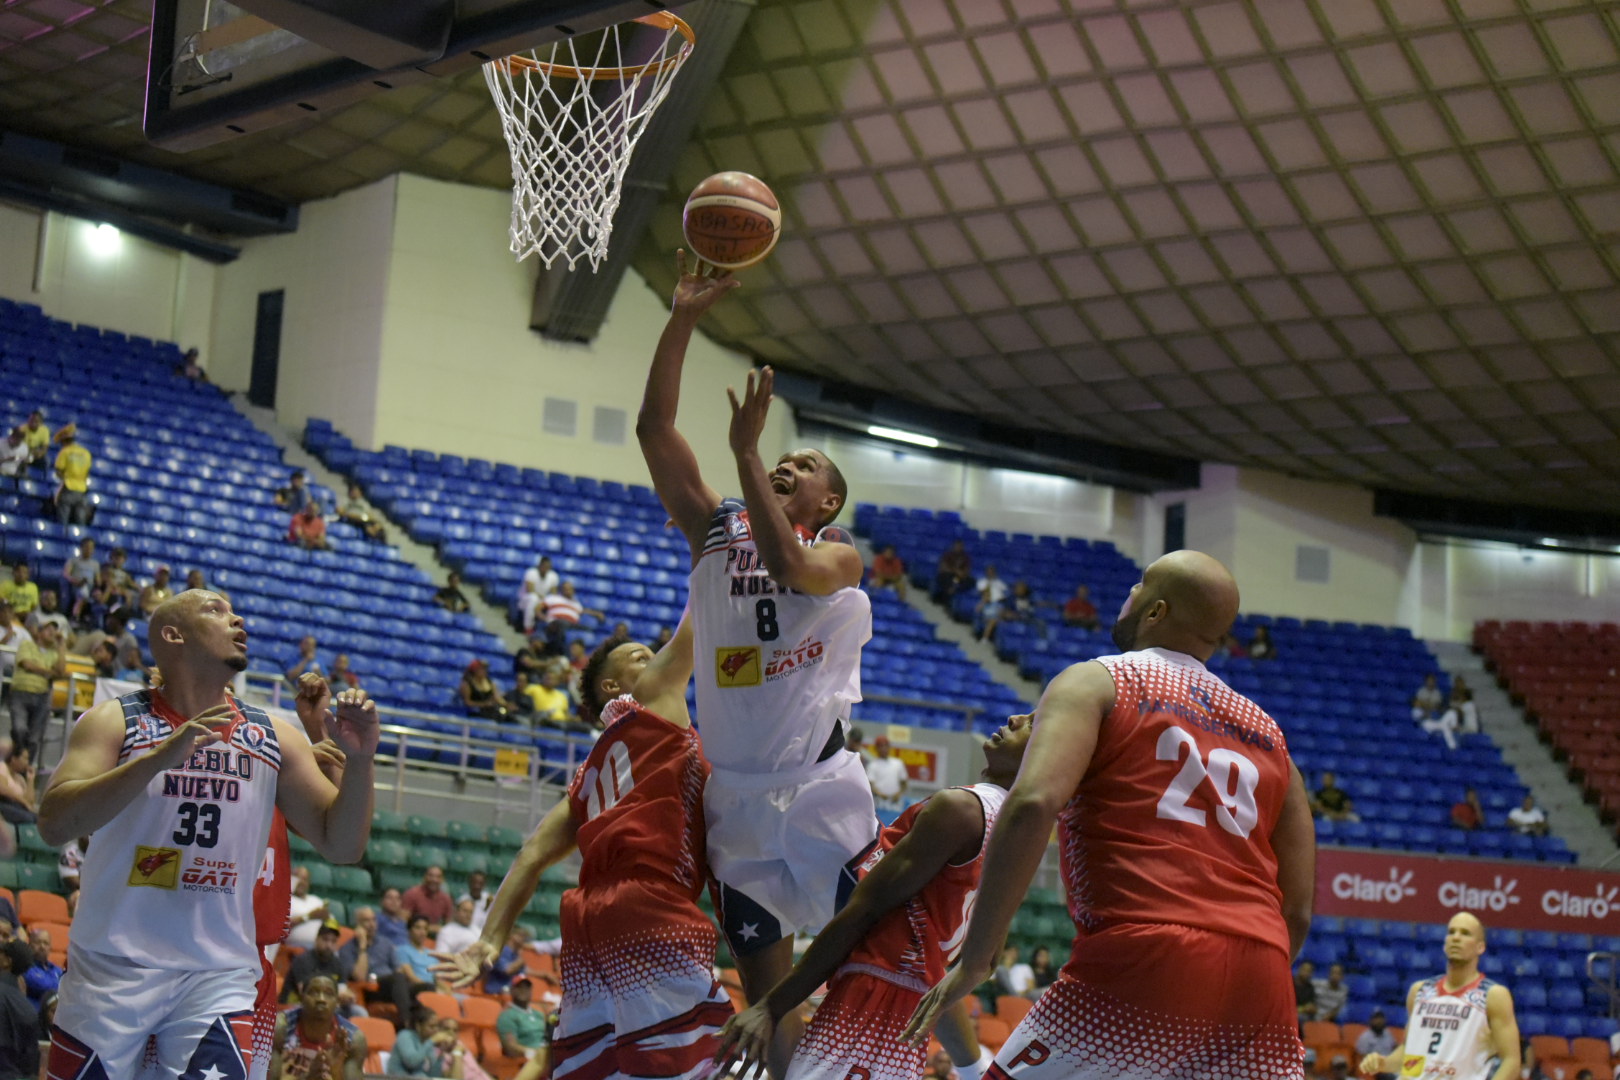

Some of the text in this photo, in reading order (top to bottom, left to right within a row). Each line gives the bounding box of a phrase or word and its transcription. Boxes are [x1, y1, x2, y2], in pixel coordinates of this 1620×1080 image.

[756, 598, 779, 641] 8
[766, 656, 824, 682] MOTORCYCLES
[174, 749, 253, 780] EBLO
[162, 773, 240, 802] NUEVO
[578, 741, 635, 821] 10
[1156, 726, 1259, 839] 29
[173, 802, 221, 848] 33
[193, 856, 237, 869] Supe
[183, 884, 236, 894] MOTORCYCL
[1332, 871, 1405, 903] Claro
[1438, 880, 1508, 911] Claro
[1541, 888, 1610, 919] Claro
[1417, 1002, 1472, 1019] PUEBLO
[1421, 1017, 1460, 1030] NUEVO
[1428, 1032, 1442, 1054] 2
